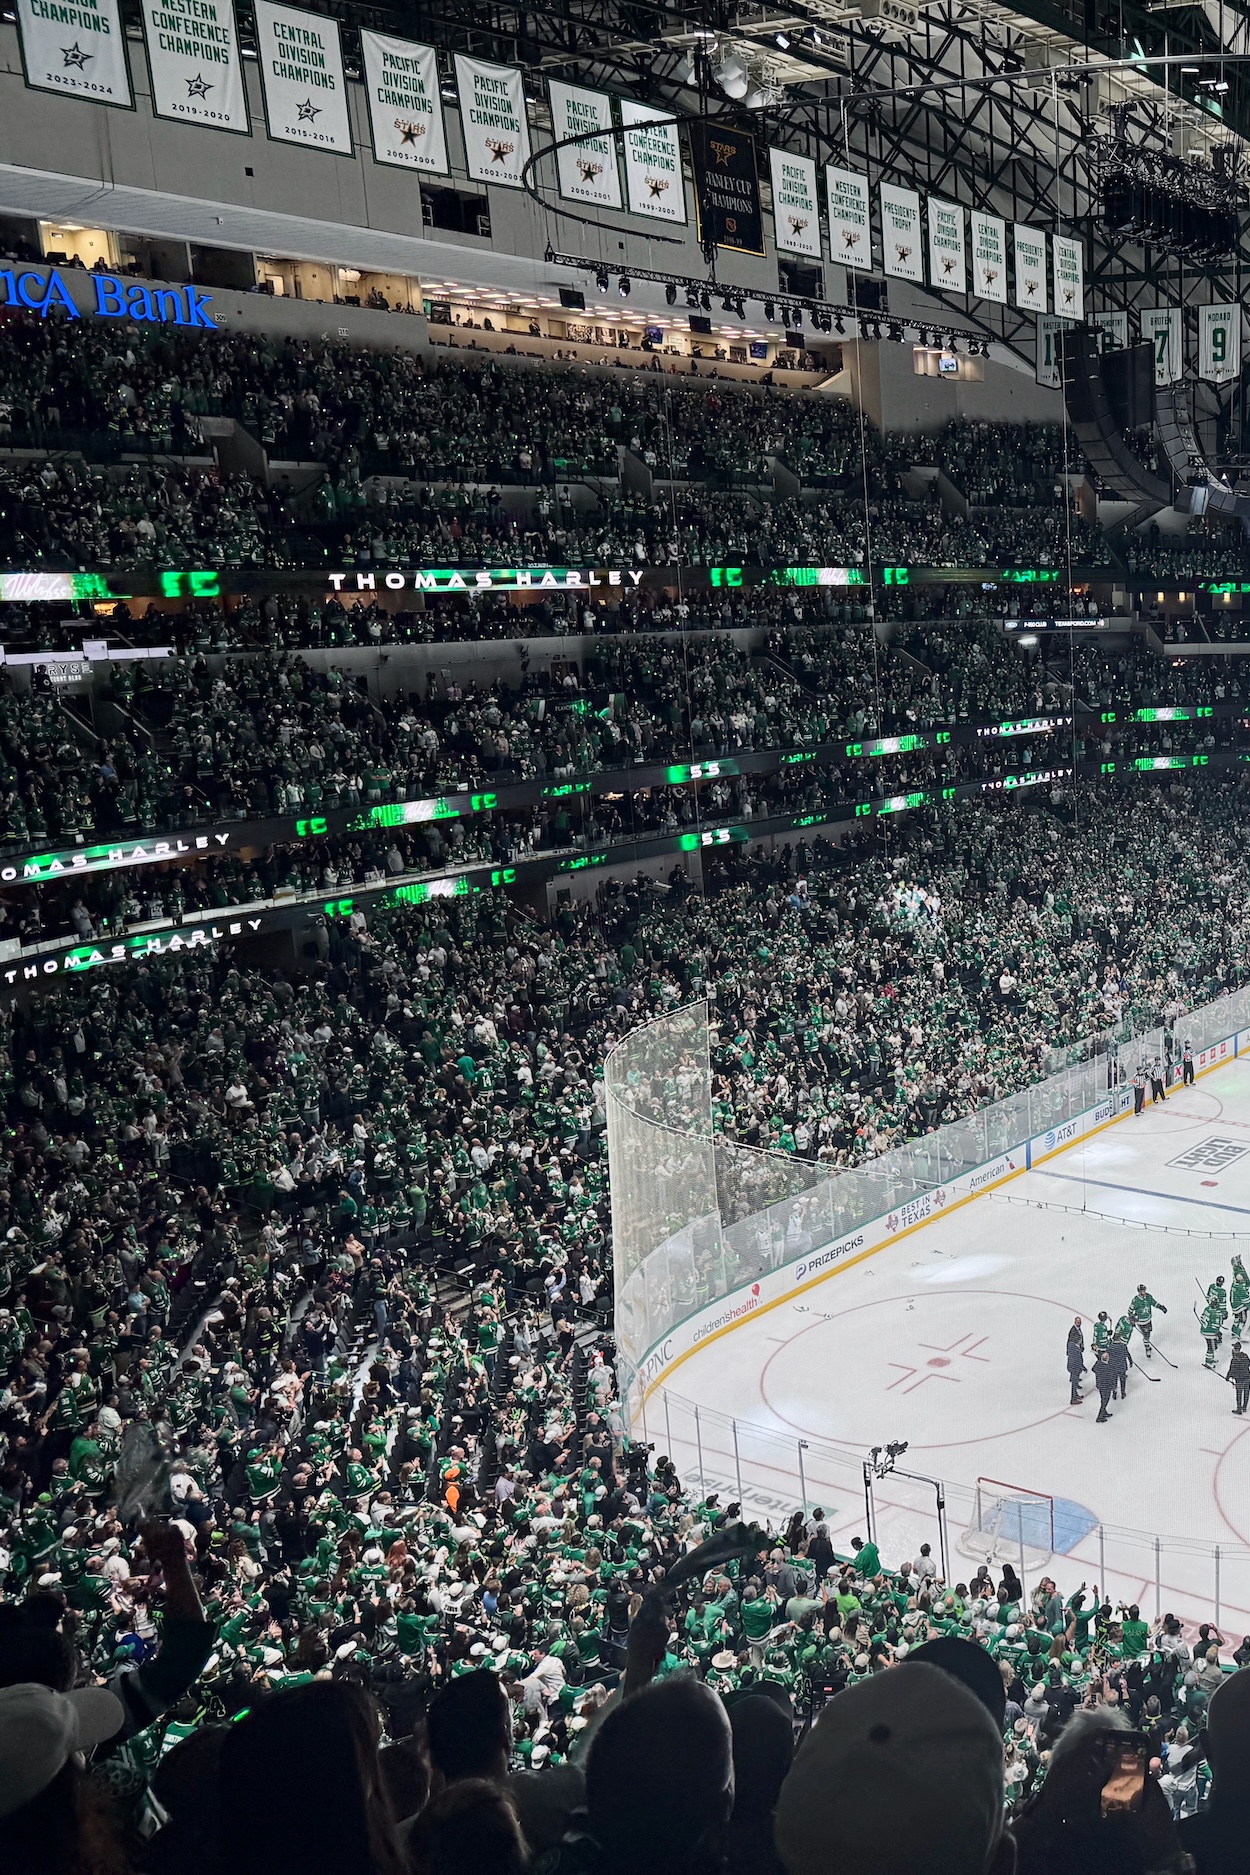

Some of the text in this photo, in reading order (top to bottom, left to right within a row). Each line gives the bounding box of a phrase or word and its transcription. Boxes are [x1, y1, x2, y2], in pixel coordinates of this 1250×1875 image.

[31, 0, 110, 34] CHAMPIONS
[152, 11, 231, 45] CONFERENCE
[273, 22, 325, 50] CENTRAL
[159, 34, 229, 64] CHAMPIONS
[278, 42, 325, 69] DIVISION
[382, 52, 421, 75] PACIFIC
[46, 73, 113, 94] 2023-2024
[272, 62, 335, 91] CHAMPIONS
[382, 70, 425, 94] DIVISION
[473, 76, 509, 96] PACIFIC
[377, 88, 433, 114] CHAMPIONS
[474, 92, 513, 114] DIVISION
[566, 99, 598, 120] PACIFIC
[171, 103, 230, 121] 2019-2020
[469, 108, 520, 133] CHAMPIONS
[567, 115, 600, 133] DIVISION
[285, 126, 335, 144] 2015-2016
[628, 132, 676, 157] CONFERENCE
[387, 150, 435, 165] 2005-2006
[710, 140, 737, 155] STARS
[632, 149, 675, 172] CHAMPIONS
[782, 164, 806, 181] PACIFIC
[571, 186, 611, 201] 2000-2001
[737, 178, 752, 196] CUP
[782, 182, 808, 196] DIVISION
[835, 180, 861, 197] WESTERN
[639, 202, 676, 216] 1999-2000
[778, 192, 813, 212] CHAMPIONS
[831, 192, 867, 213] CONFERENCE
[833, 207, 865, 226] CHAMPIONS
[892, 216, 911, 232] TROPHY
[937, 210, 956, 226] PACIFIC
[937, 225, 958, 239] DIVISION
[978, 223, 999, 239] CENTRAL
[934, 235, 961, 252] CHAMPIONS
[979, 236, 999, 251] DIVISION
[1059, 246, 1077, 261] CENTRAL
[976, 248, 1002, 265] CHAMPIONS
[1022, 254, 1039, 268] TROPHY
[1060, 259, 1077, 272] DIVISION
[89, 273, 218, 329] Bank
[1151, 316, 1172, 326] BROTEN
[1155, 330, 1168, 363] 7
[1212, 327, 1226, 362] 9
[328, 570, 645, 591] THOMAS HARLEY
[977, 717, 1073, 737] THOMAS HARLEY
[1030, 768, 1073, 783] HARLEY
[108, 833, 230, 862] HARLEY
[4, 919, 262, 980] THOMAS HARLEY
[1094, 1107, 1111, 1122] BUD
[1056, 1122, 1078, 1144] AT&T
[1175, 1137, 1233, 1169] LIGHT
[1202, 1146, 1248, 1168] BUD
[969, 1162, 1005, 1189] American
[901, 1193, 930, 1217] BEST IN
[901, 1204, 931, 1228] TEXAS
[807, 1234, 864, 1272] PRIZEPICKS
[645, 1339, 674, 1379] PNC
